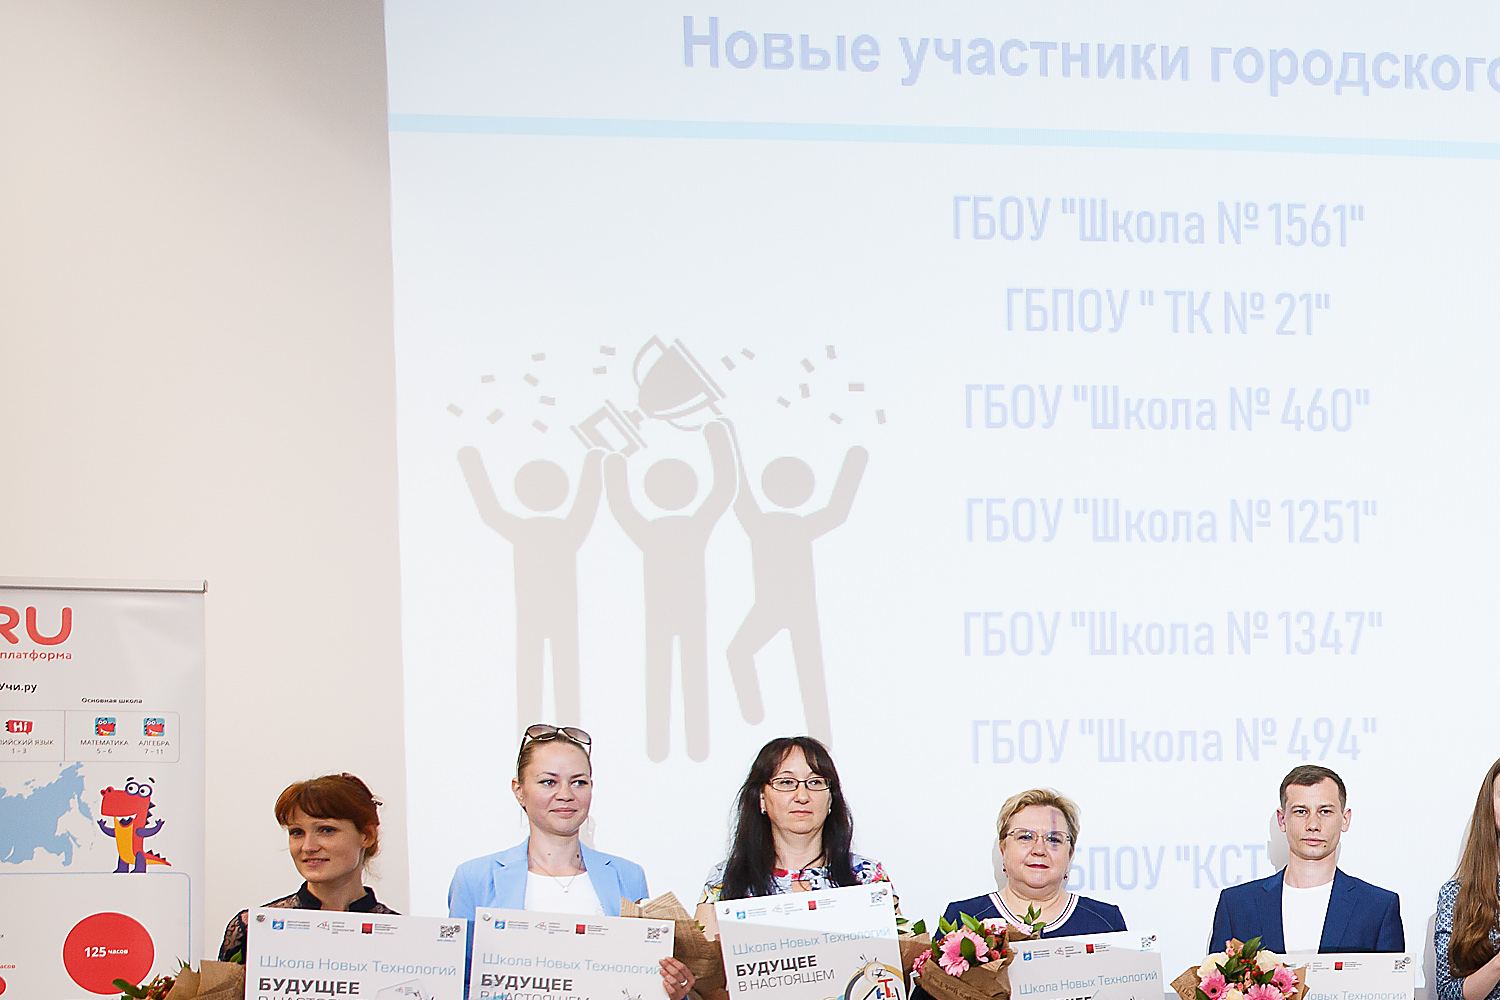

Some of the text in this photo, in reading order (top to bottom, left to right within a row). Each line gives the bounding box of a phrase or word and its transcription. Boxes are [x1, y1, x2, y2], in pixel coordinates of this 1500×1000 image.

[681, 16, 881, 74] Новые
[899, 36, 1191, 87] участники
[952, 196, 1366, 248] ГБОУ "Школа № 1561"
[1004, 288, 1331, 336] ГБПОУ ТК № 21"
[963, 384, 1370, 434] ГБОУ "Школа № 460"
[964, 497, 1378, 544] ГБОУ "Школа № 1251"
[963, 611, 1383, 657] ГБОУ "Школа № 1347"
[13, 722, 28, 732] Hi
[80, 739, 130, 747] МАТЕМАТИКА
[970, 717, 1378, 765] ГБОУ "Школа № 494"
[1066, 845, 1166, 891] БПОУ
[84, 946, 107, 958] 125
[732, 927, 891, 956] Школа Новых Технологий
[259, 955, 457, 976] Школа Новых Технологий
[482, 953, 662, 975] Школа Новых Технологий
[736, 954, 817, 977] БУДУЩЕЕ
[258, 977, 361, 996] БУДУЩЕЕ
[481, 973, 573, 992] БУДУЩЕЕ
[738, 969, 835, 992] В НАСТОЯЩЕМ
[1019, 971, 1158, 995] Школа Новых Технологий
[1341, 991, 1407, 1000] Технологий
